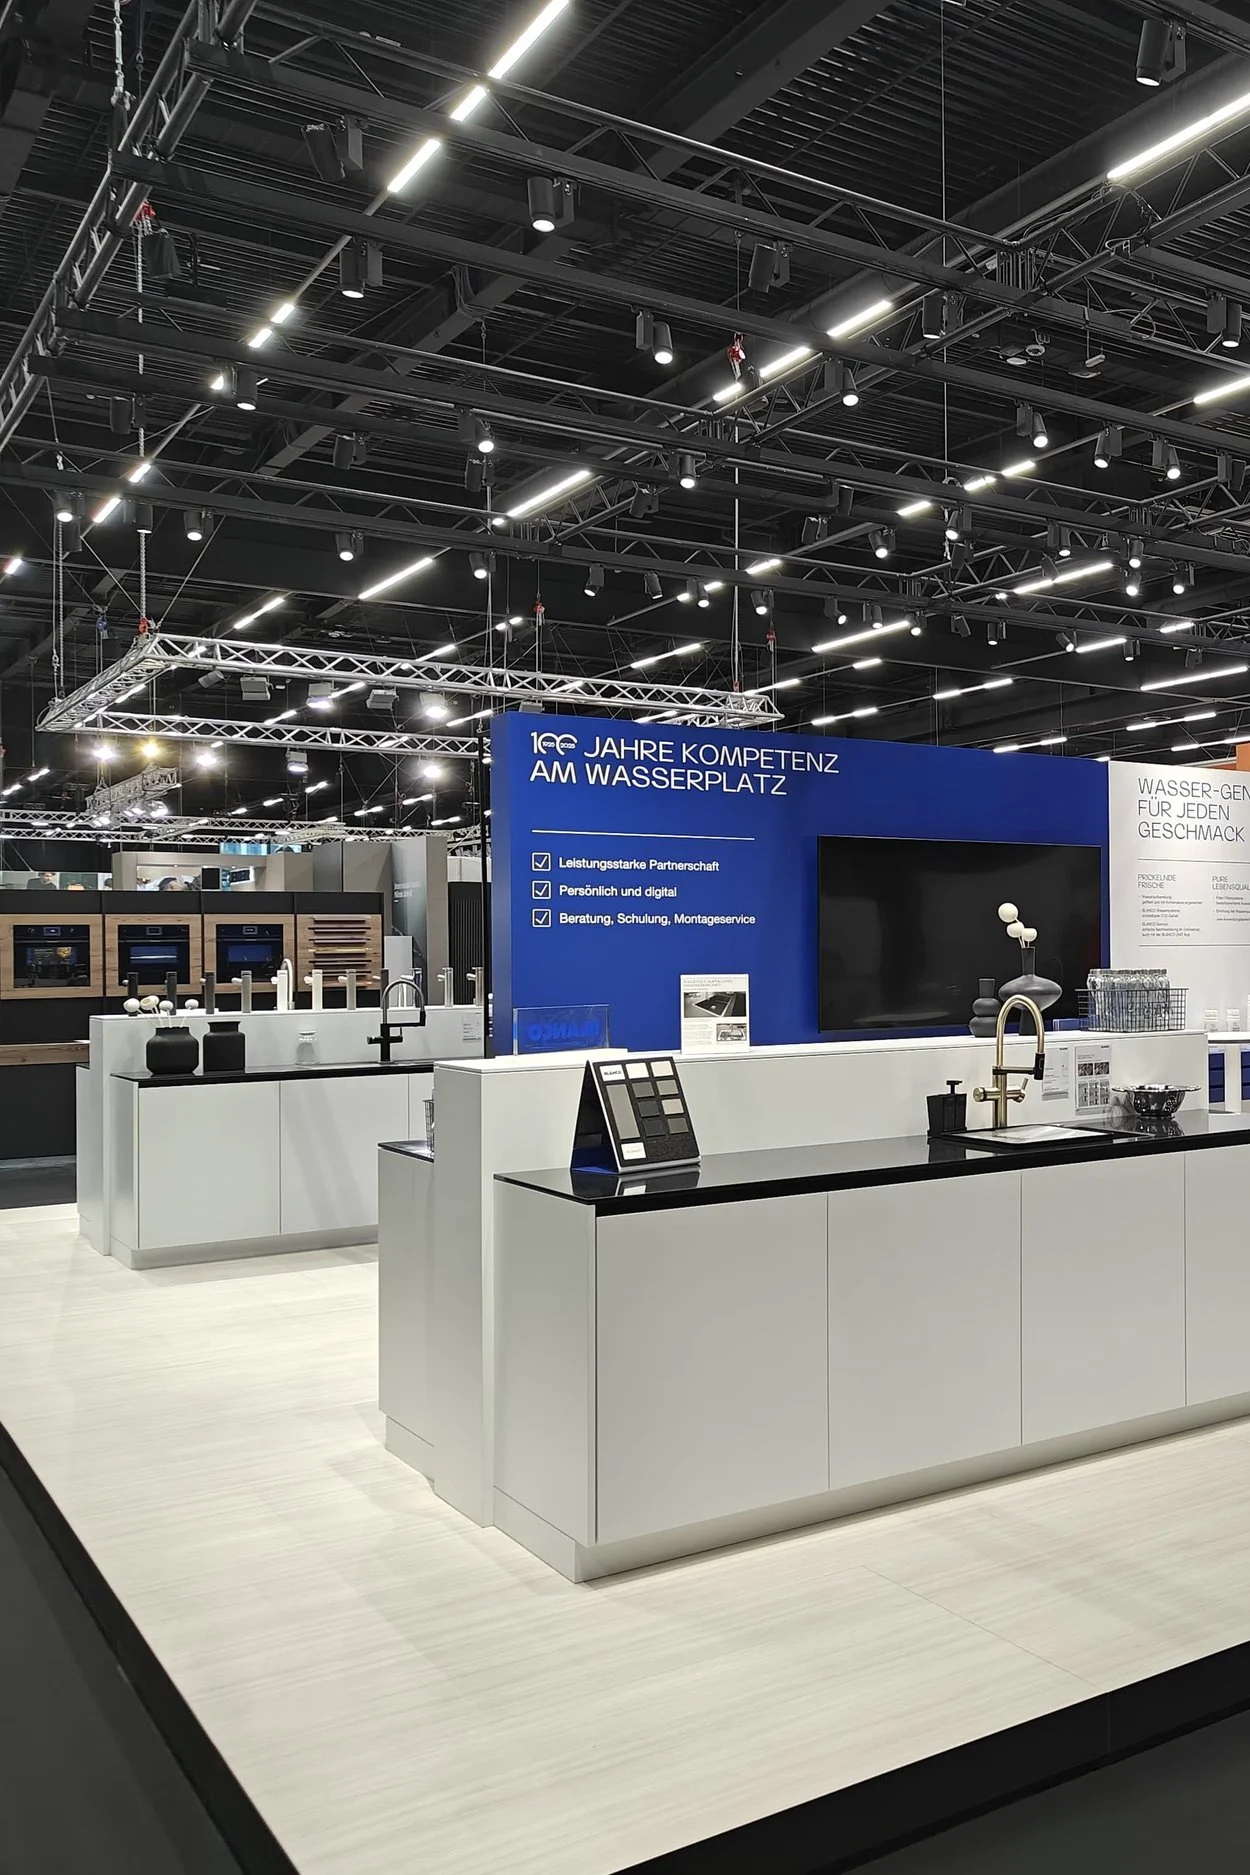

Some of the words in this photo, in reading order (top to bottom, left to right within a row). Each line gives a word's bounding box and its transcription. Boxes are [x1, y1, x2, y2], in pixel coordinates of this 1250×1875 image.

[542, 740, 555, 748] 1925
[560, 741, 576, 749] 2025
[584, 736, 675, 763] JAHRE
[682, 743, 840, 774] KOMPETENZ
[529, 760, 577, 784] AM
[585, 763, 788, 796] WASSERPLATZ
[1138, 798, 1172, 818] FÜR
[1177, 802, 1230, 821] JEDEN
[1138, 821, 1246, 843] GESCHMACK
[559, 857, 647, 872] Leistungsstarke
[649, 859, 720, 872] Partnerschaft
[1138, 873, 1176, 881] PRICKELNDE
[559, 884, 618, 897] Persönlich
[620, 886, 642, 897] und
[644, 886, 677, 900] digital
[559, 912, 614, 926] Beratung,
[617, 913, 671, 926] Schulung,
[674, 913, 756, 926] Montageservice
